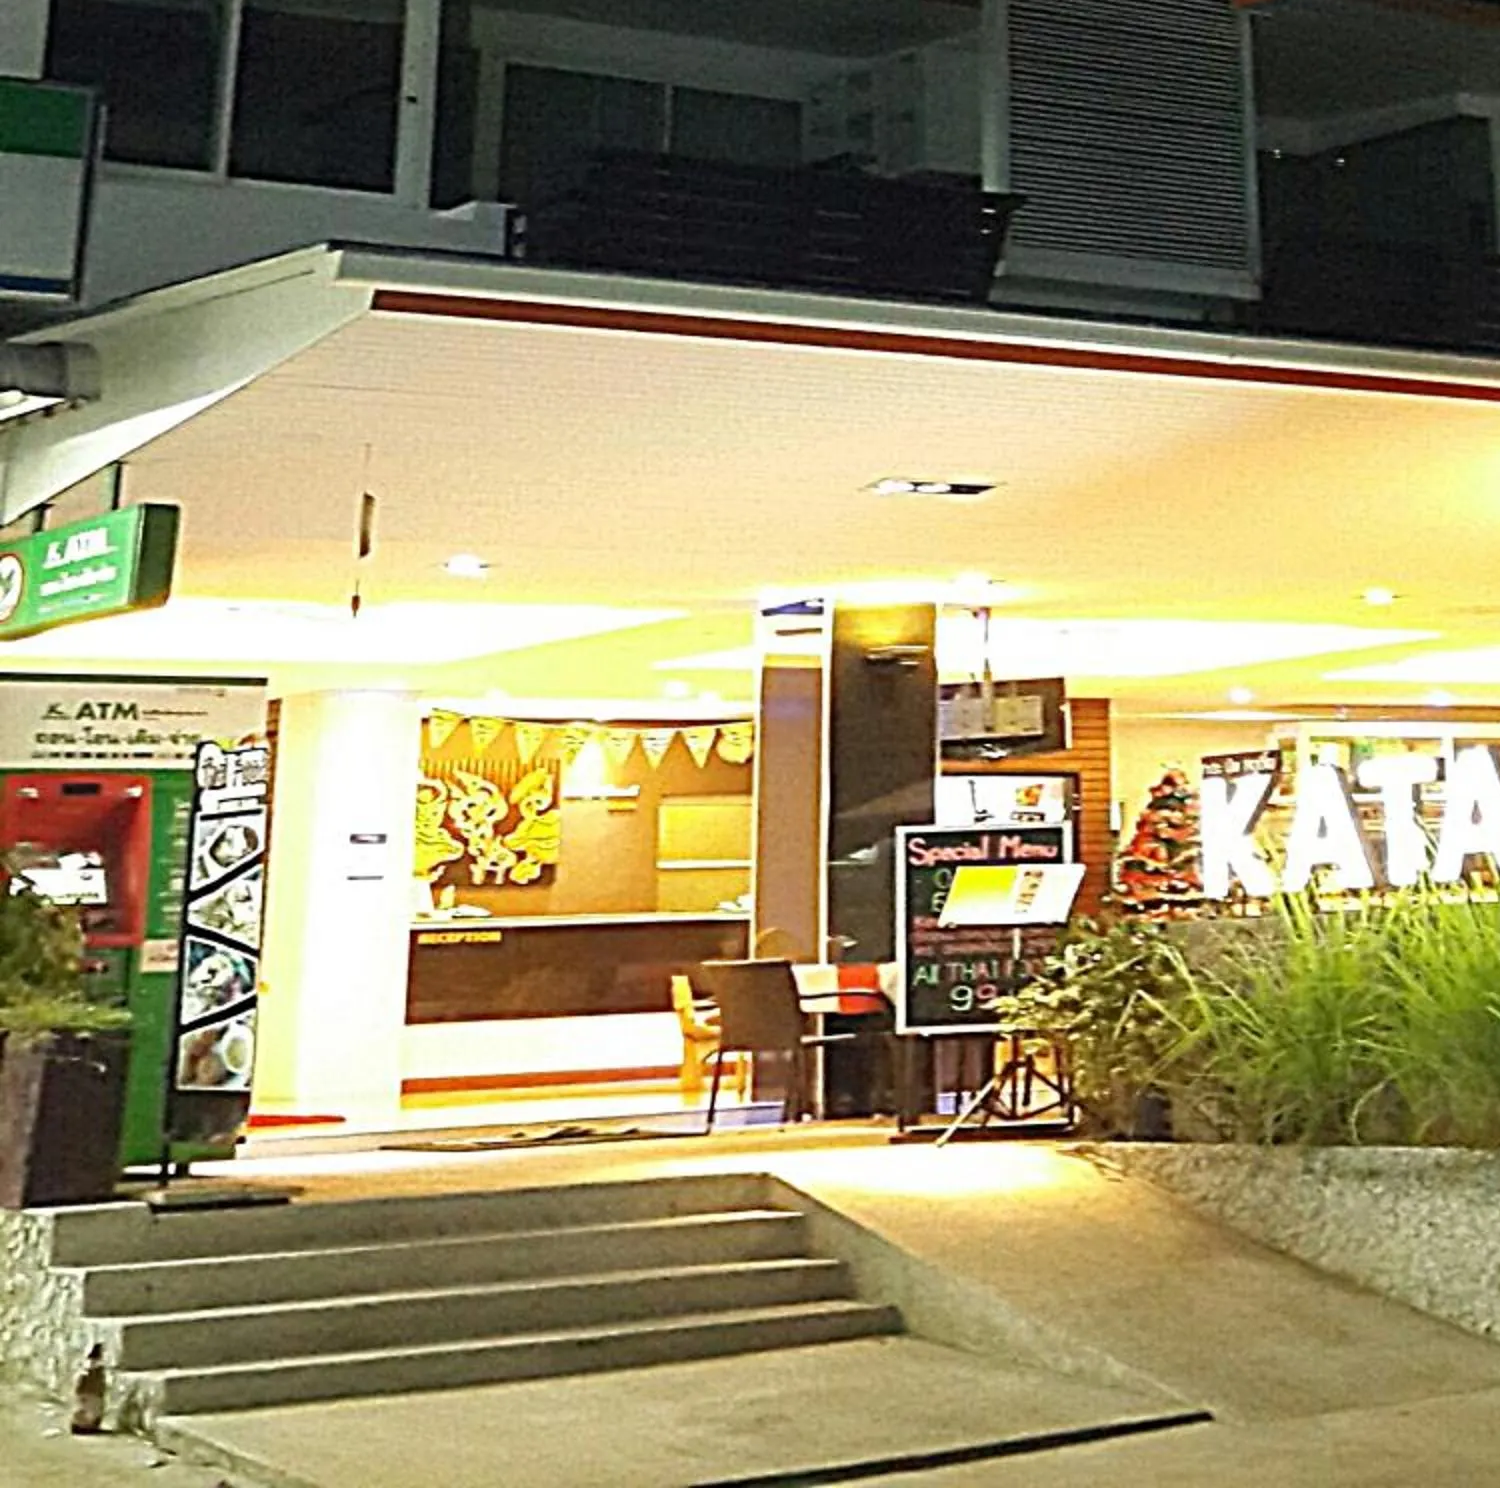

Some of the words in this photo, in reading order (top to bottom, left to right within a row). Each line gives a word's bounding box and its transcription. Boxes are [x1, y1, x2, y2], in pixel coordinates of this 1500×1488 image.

[75, 701, 139, 720] ATM
[907, 834, 990, 866] Special
[998, 834, 1058, 859] Menu
[945, 959, 999, 982] THAI
